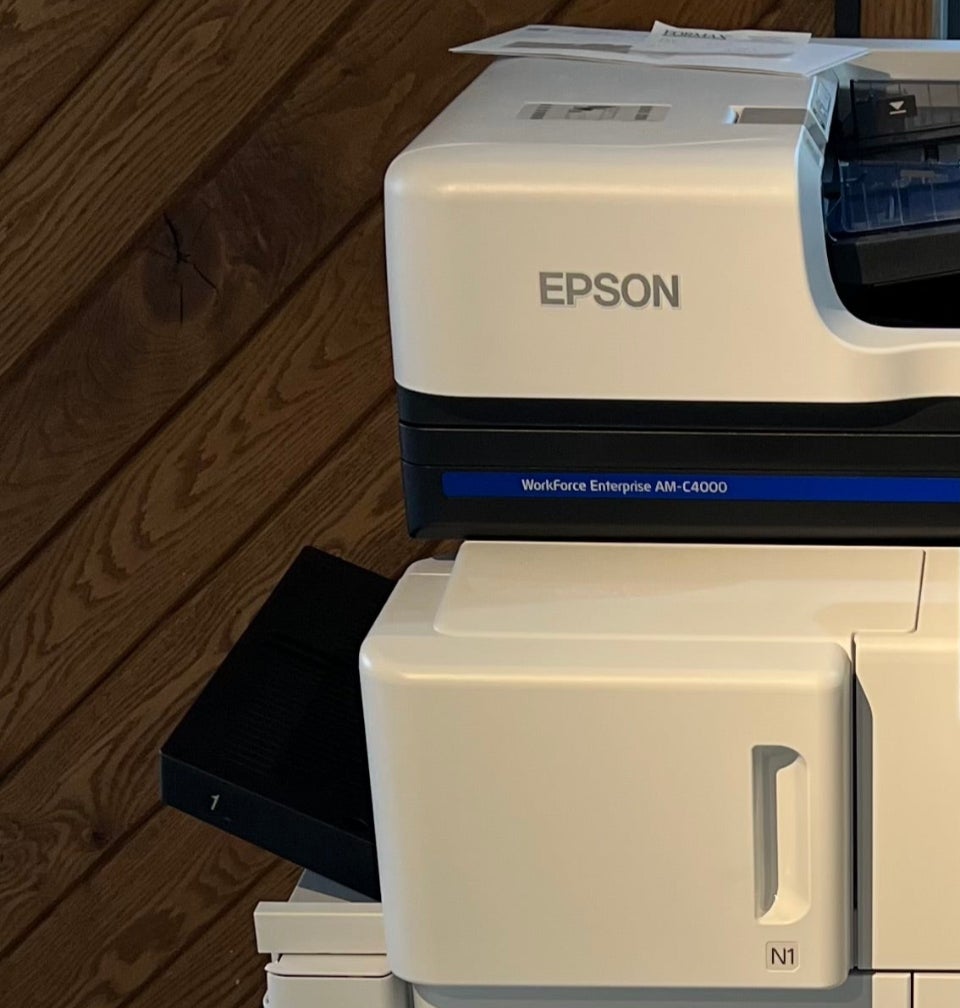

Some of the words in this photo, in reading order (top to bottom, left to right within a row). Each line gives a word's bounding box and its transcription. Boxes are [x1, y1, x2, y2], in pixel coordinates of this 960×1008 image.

[539, 271, 680, 308] EPSON
[521, 478, 586, 492] WorkForce
[590, 479, 652, 494] Enterprise
[655, 480, 728, 494] AM-C4000
[211, 794, 220, 811] 1
[771, 947, 795, 966] N1
